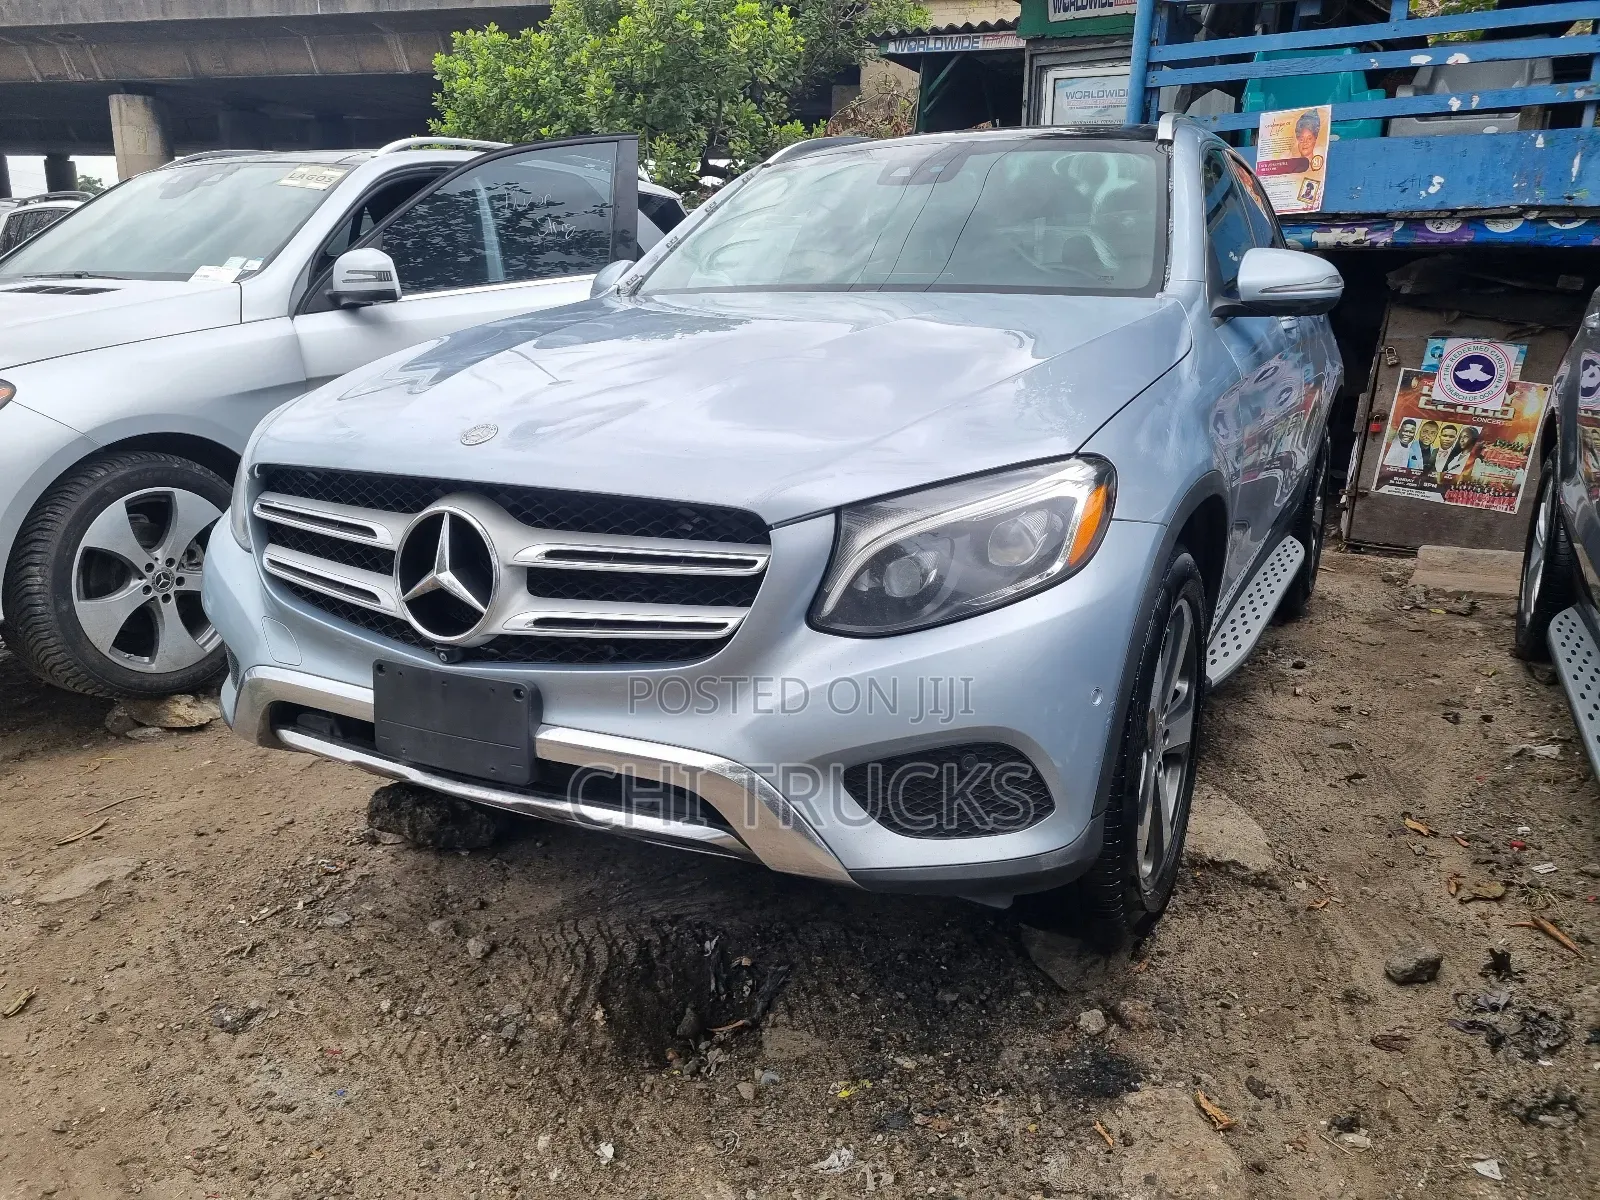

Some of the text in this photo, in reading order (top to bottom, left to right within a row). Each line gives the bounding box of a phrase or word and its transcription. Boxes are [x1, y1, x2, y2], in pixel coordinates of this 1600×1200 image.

[893, 35, 981, 52] WORLDWIDE
[288, 173, 334, 183] LAGOS
[1449, 345, 1490, 362] REDEEMED
[1490, 350, 1506, 384] CHRISTIAN
[1445, 384, 1468, 401] CHURCH
[1479, 390, 1494, 400] GOD
